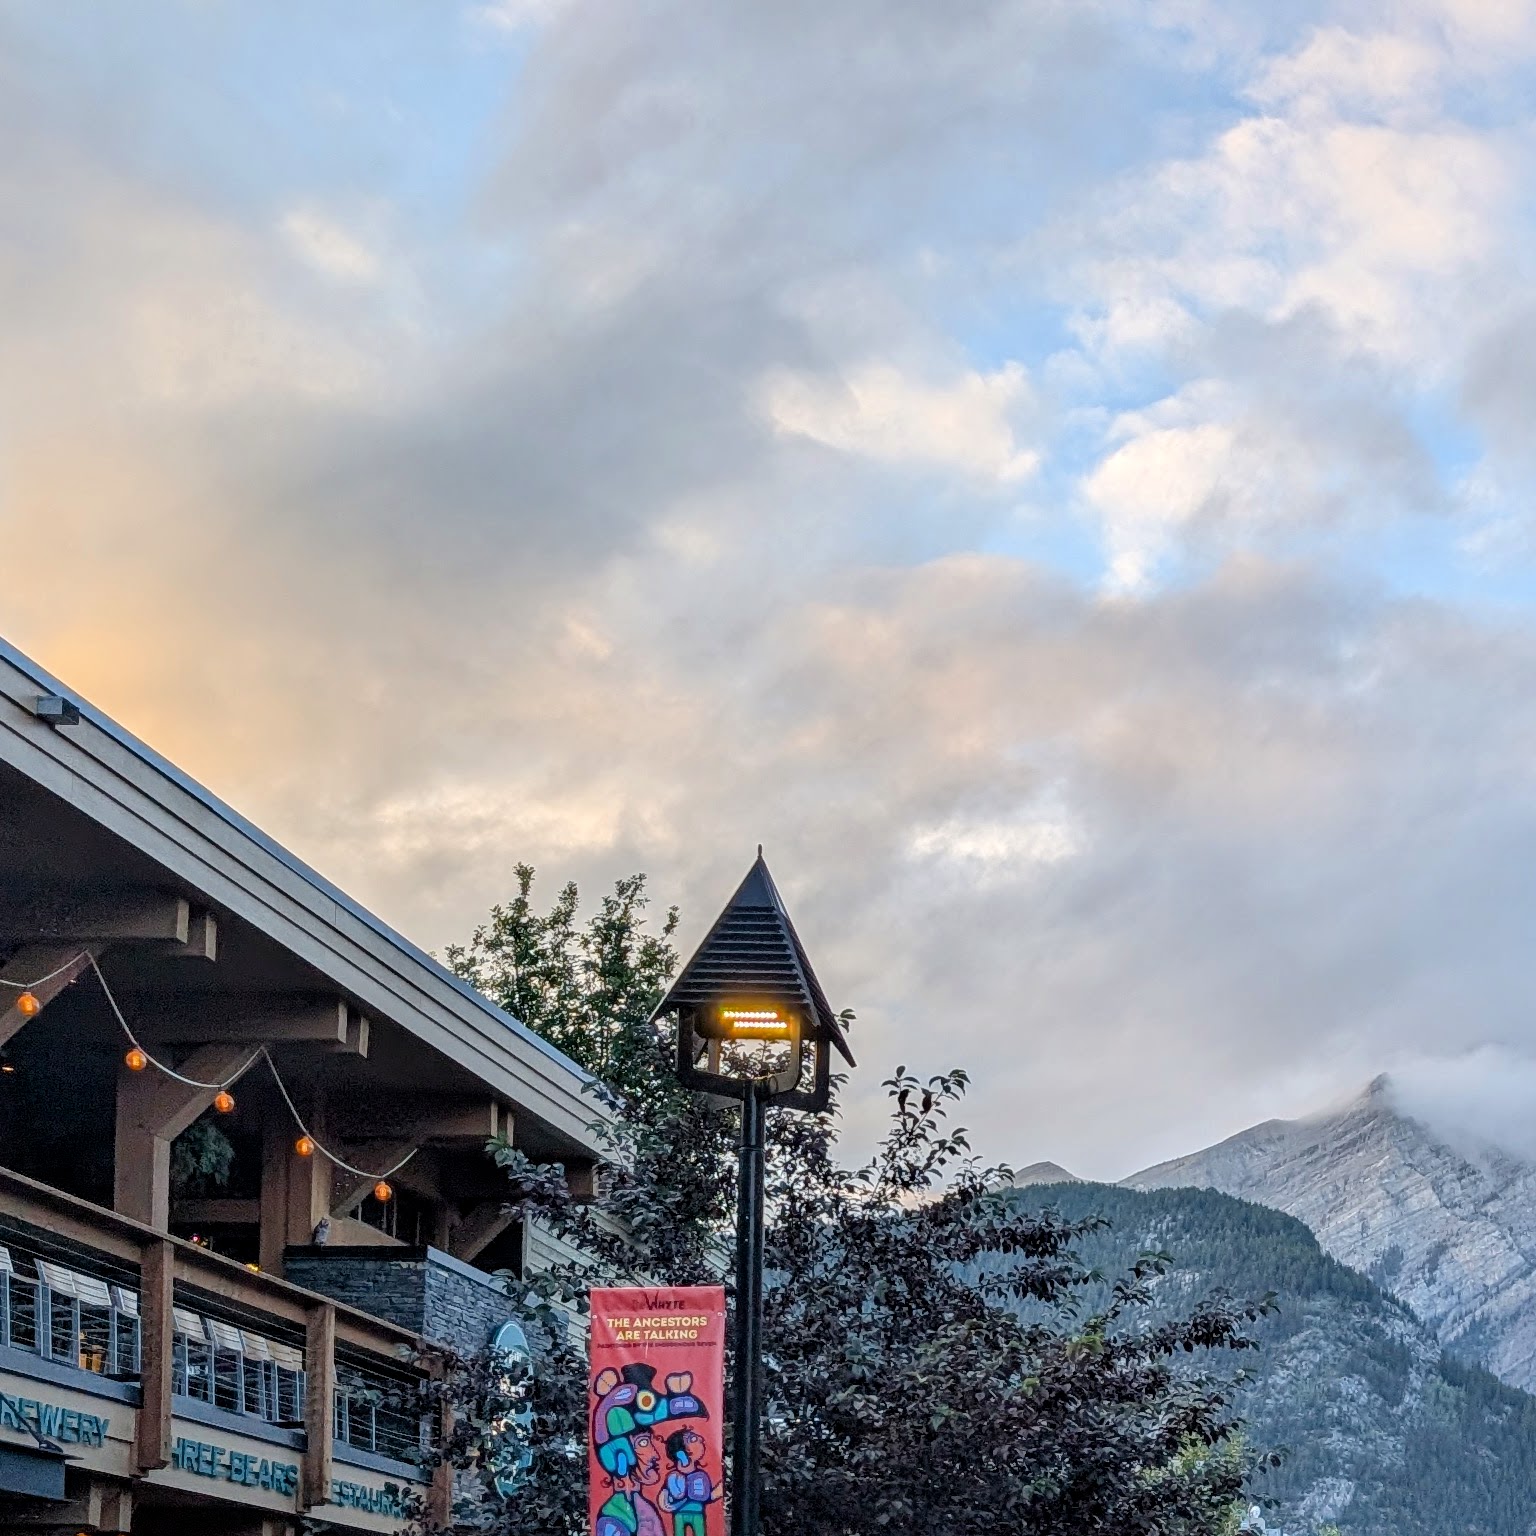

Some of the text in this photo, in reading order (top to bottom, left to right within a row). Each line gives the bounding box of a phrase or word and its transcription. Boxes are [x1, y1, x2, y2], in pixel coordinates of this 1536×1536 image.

[643, 1290, 685, 1310] WHYTE
[607, 1317, 708, 1328] THE ANCESTORS
[616, 1330, 698, 1341] ARE TALKING
[0, 1392, 110, 1448] REWERY
[171, 1437, 230, 1479] HREE
[230, 1450, 299, 1497] BEARS
